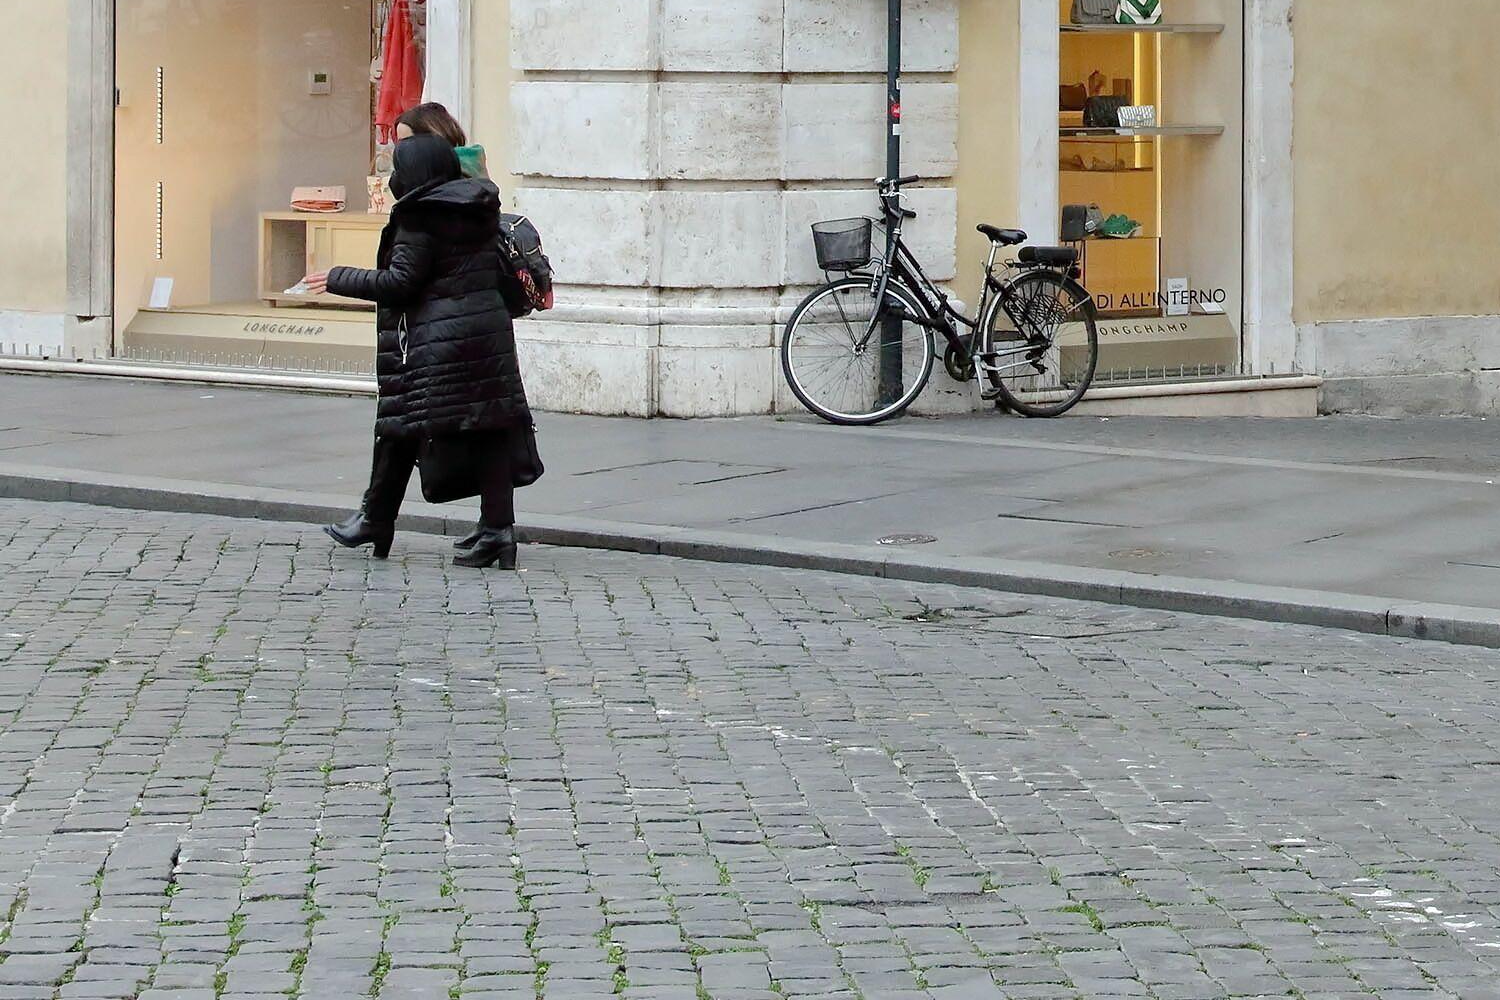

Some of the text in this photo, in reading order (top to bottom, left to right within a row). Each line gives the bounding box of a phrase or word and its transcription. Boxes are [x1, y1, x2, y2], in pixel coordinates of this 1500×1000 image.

[1120, 288, 1226, 309] ALL'INTERNO
[243, 322, 324, 335] LONGCHAMP
[1100, 322, 1188, 336] ONGCHAMP
